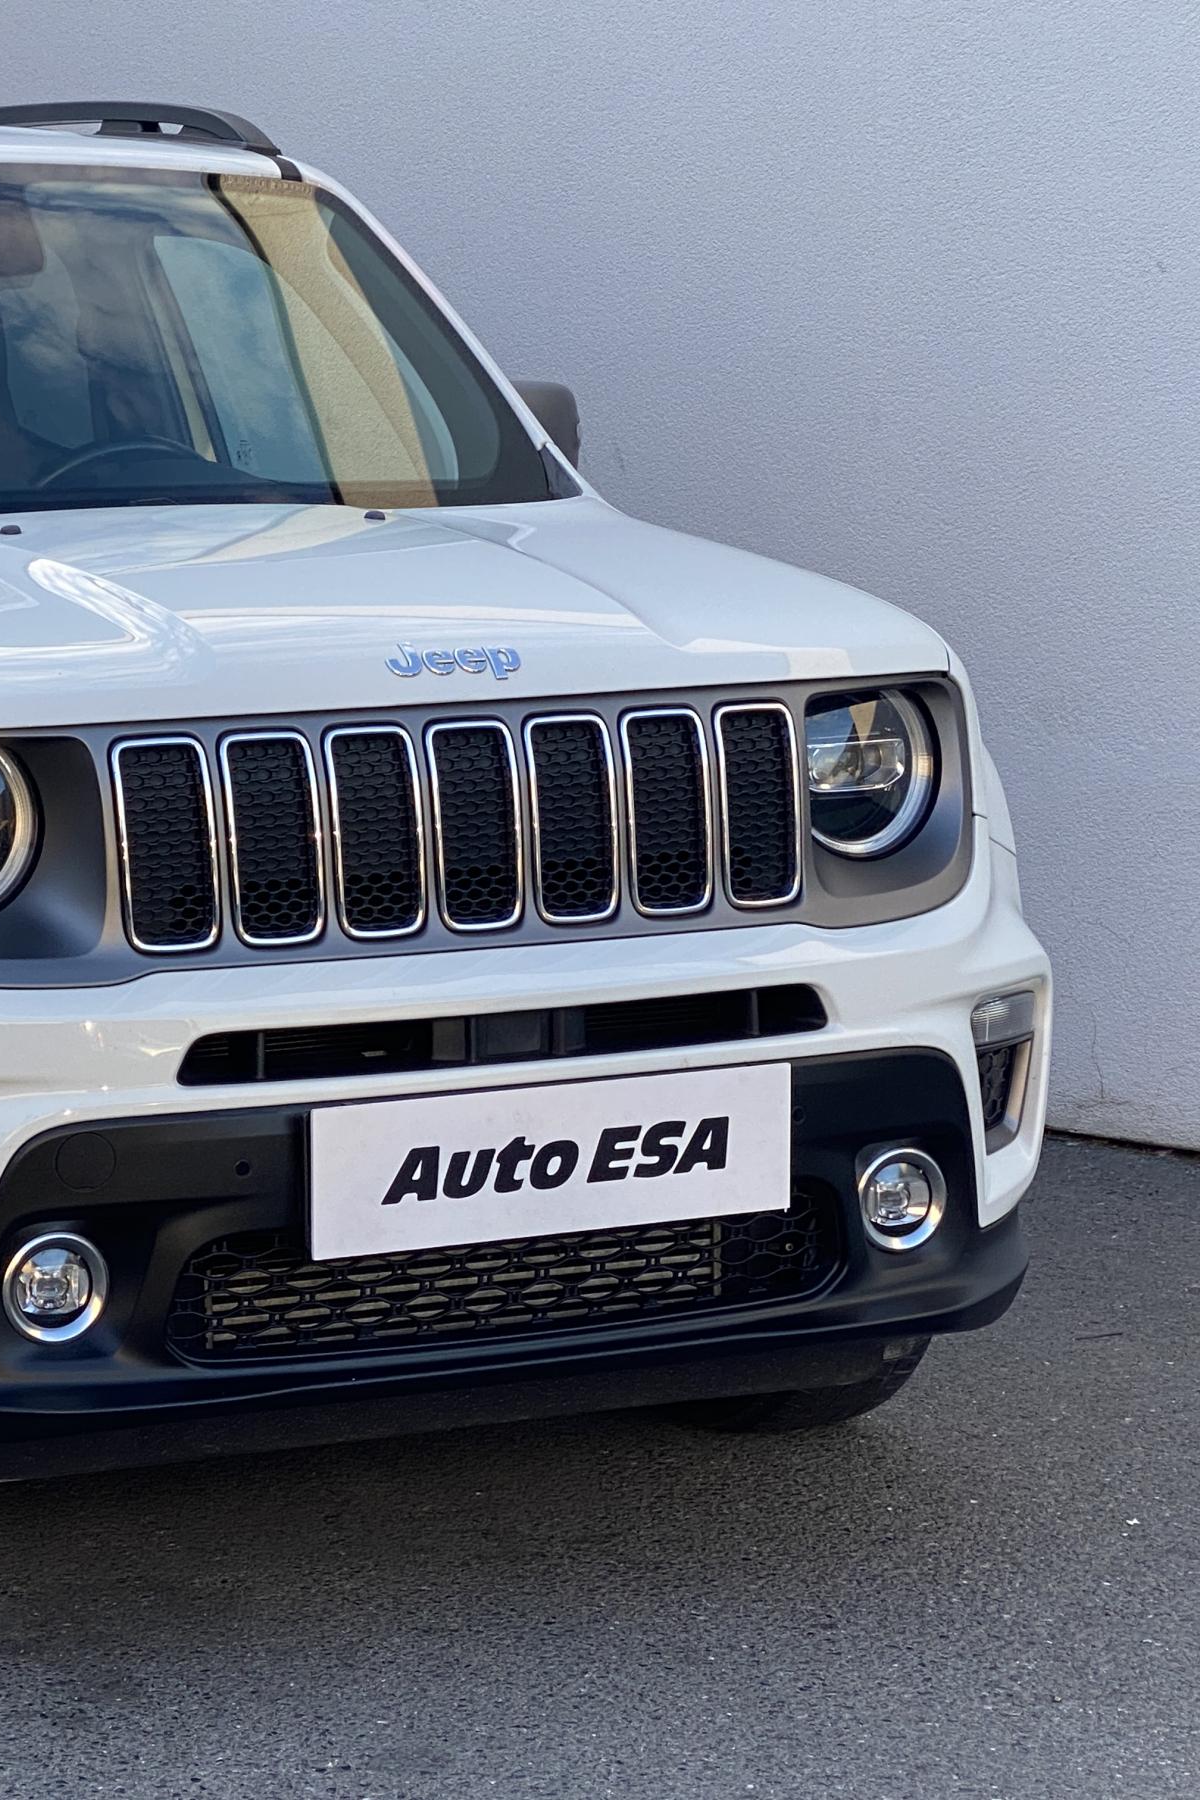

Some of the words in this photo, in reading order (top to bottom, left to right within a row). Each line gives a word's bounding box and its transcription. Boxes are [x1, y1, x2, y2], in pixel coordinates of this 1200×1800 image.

[385, 641, 521, 680] Jeep
[381, 1136, 579, 1205] Auto
[586, 1116, 729, 1183] ESA
